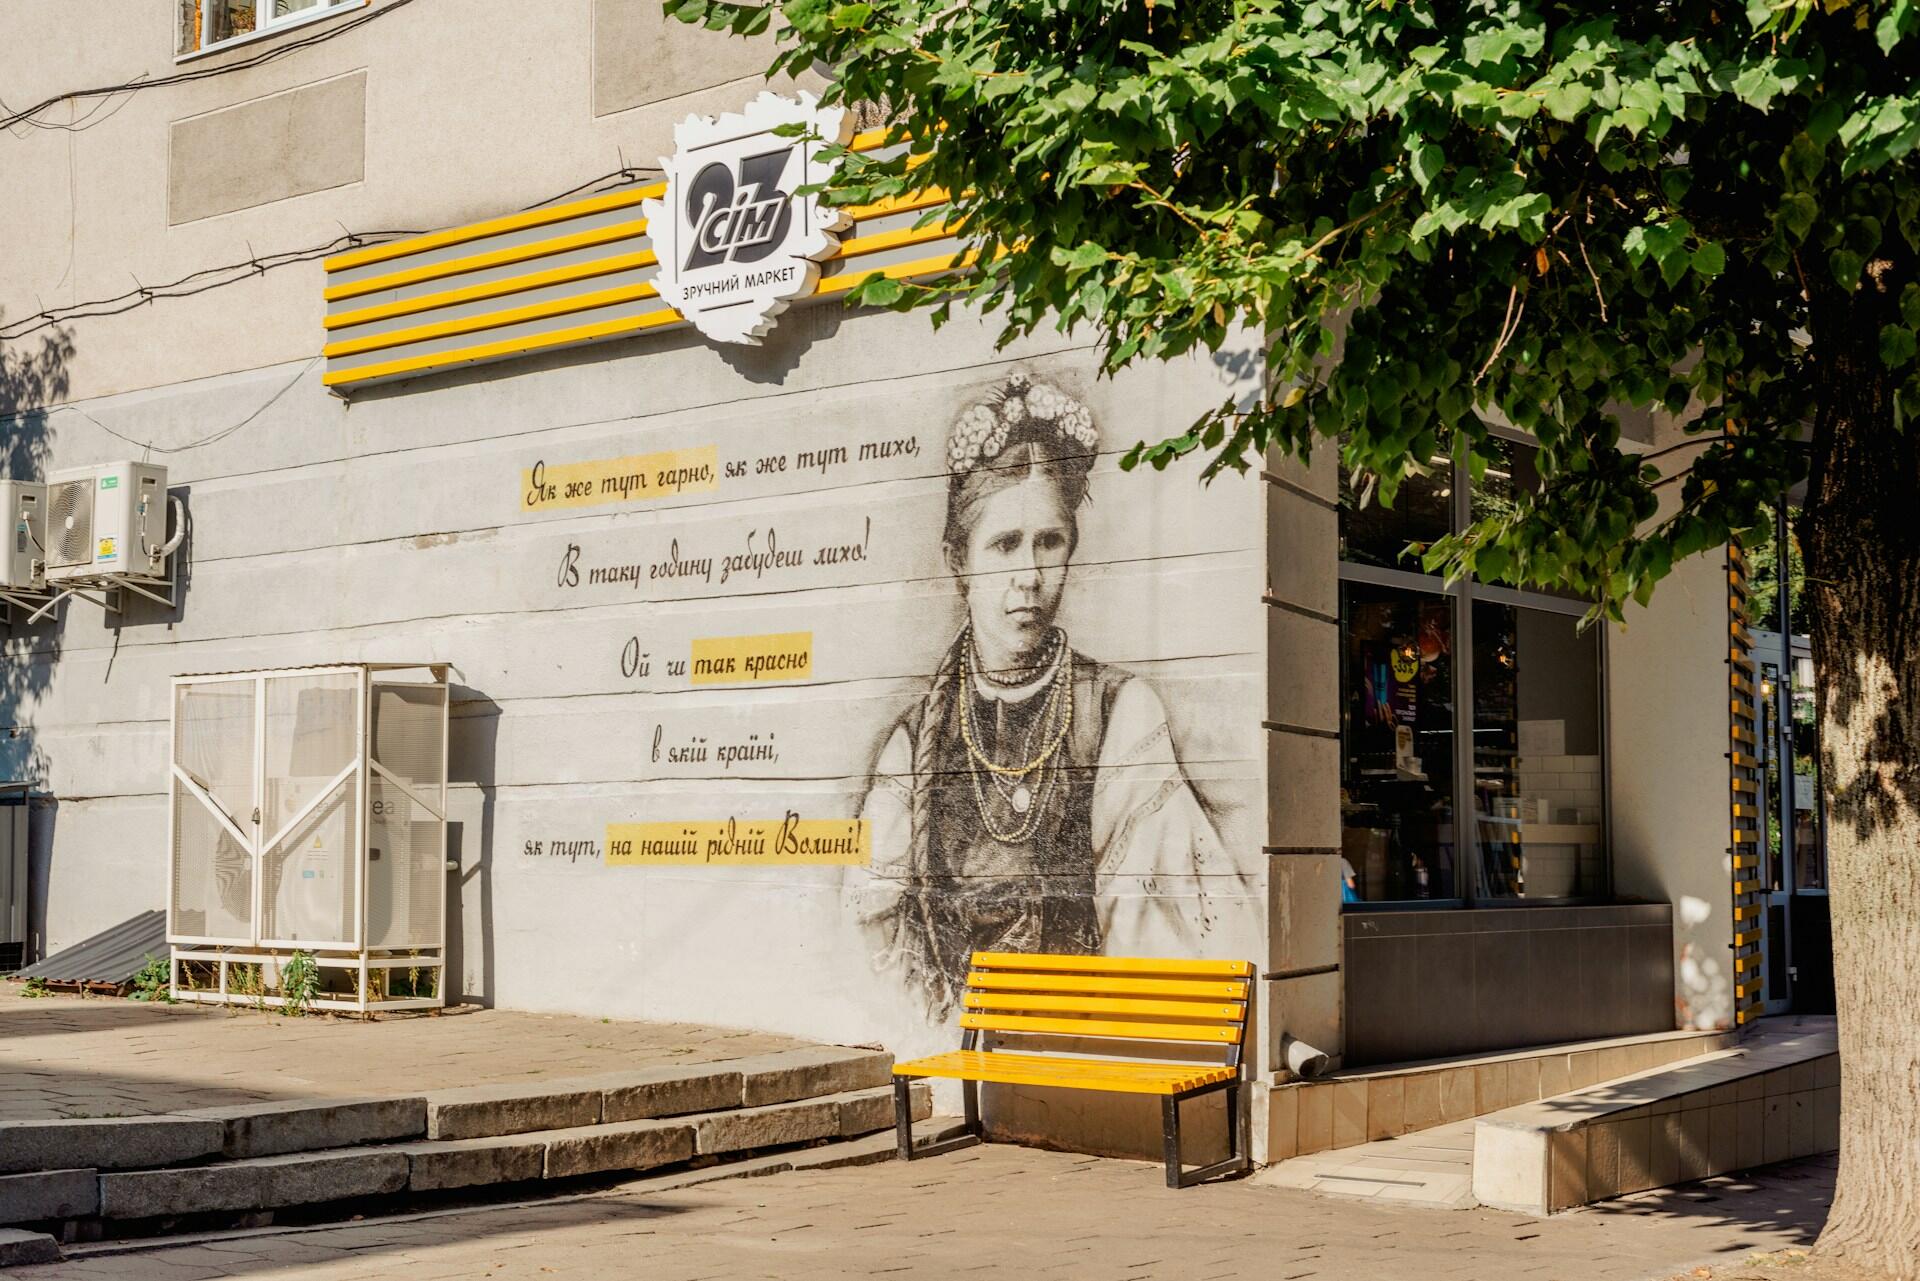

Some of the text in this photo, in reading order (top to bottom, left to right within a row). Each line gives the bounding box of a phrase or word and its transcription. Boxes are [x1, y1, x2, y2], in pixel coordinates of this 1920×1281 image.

[683, 266, 796, 300] ЗРУЧНИЙ МАРКЕТ
[527, 435, 921, 506] Як же тут гарно, як же тут тихо,
[557, 516, 871, 589] В таку годину забудеш лихо!
[621, 636, 809, 679] Ой чи так красно
[668, 737, 708, 763] якій
[716, 732, 779, 769] країні,
[524, 809, 863, 863] як тут, на нашій рідній Волині!
